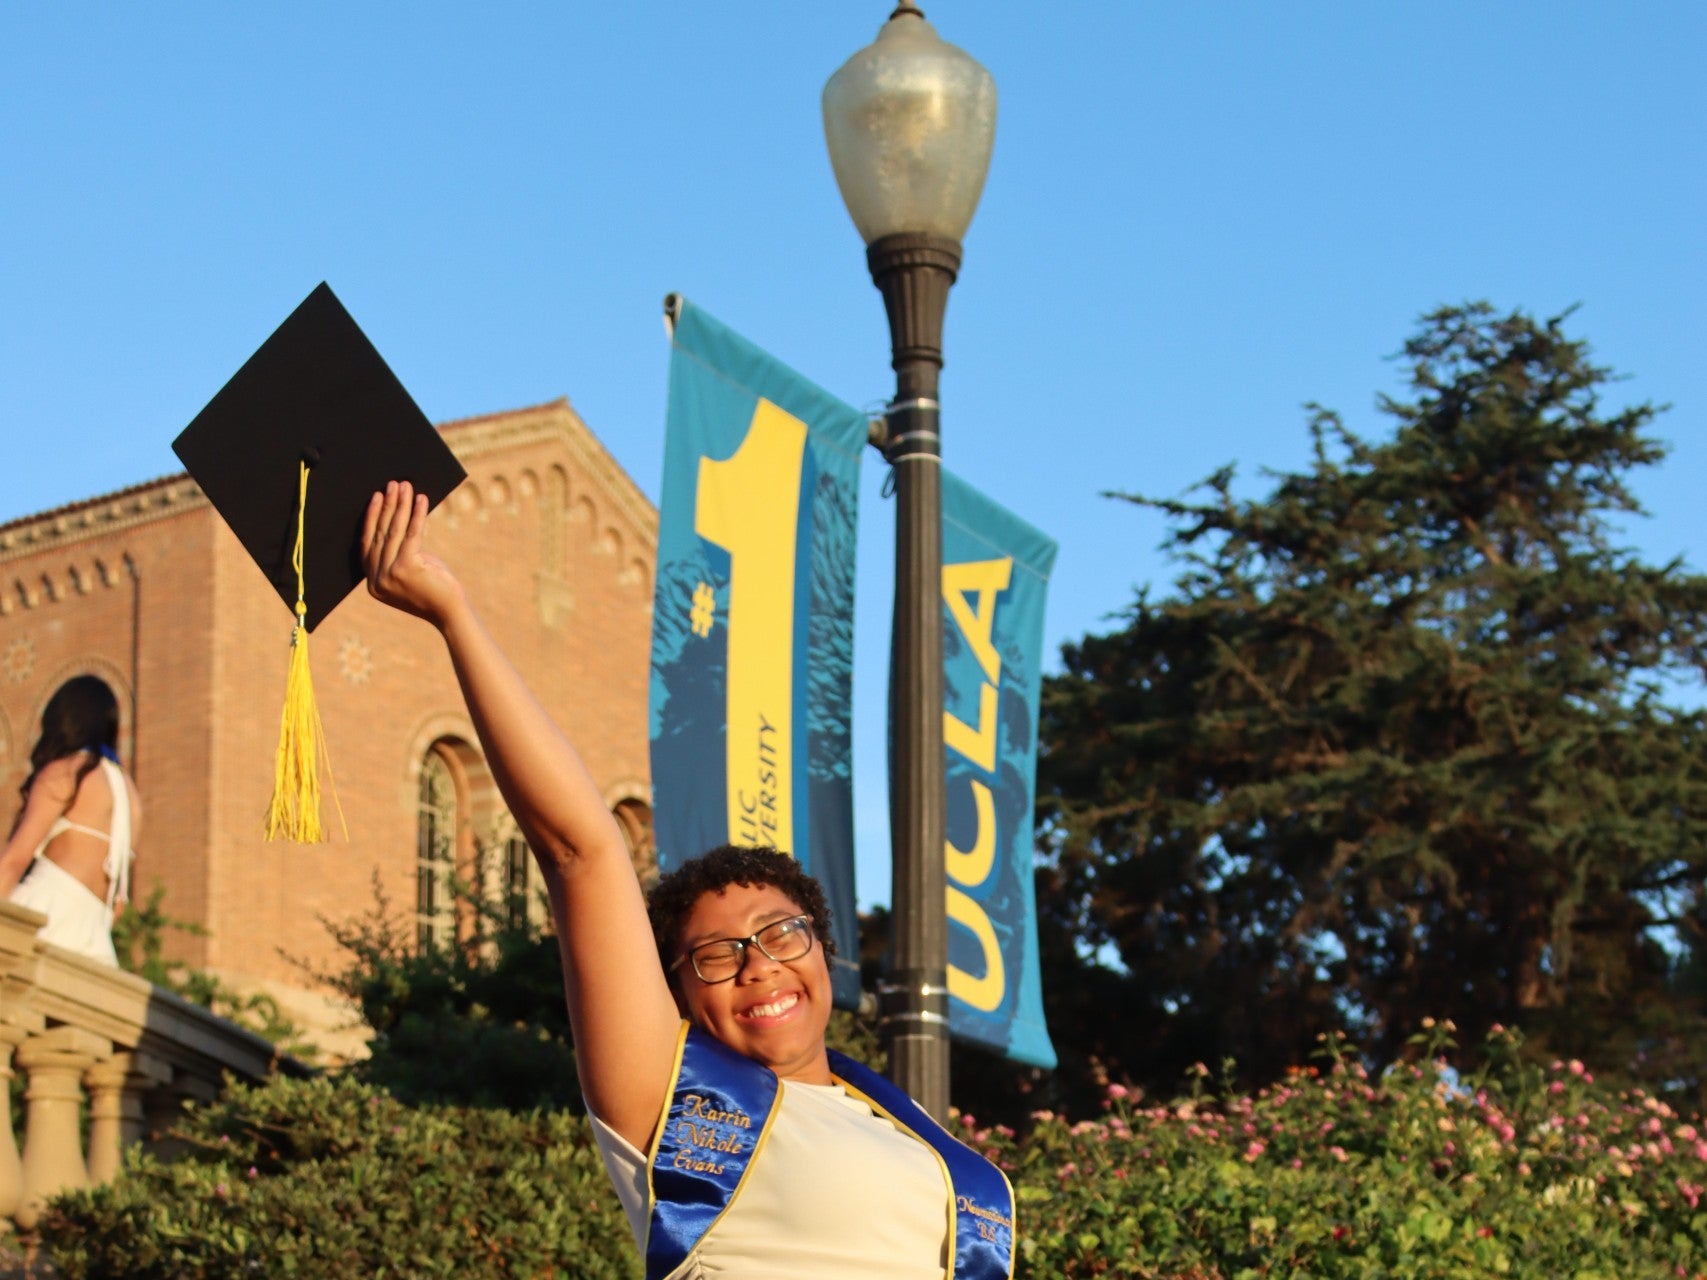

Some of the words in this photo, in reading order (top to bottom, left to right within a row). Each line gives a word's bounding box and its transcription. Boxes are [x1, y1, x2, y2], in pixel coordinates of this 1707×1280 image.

[759, 712, 778, 852] VERSITY
[941, 557, 1012, 1013] UCLA
[738, 788, 758, 846] LIC
[682, 1094, 751, 1129] Karrin
[675, 1122, 743, 1155] Nikole
[673, 1149, 725, 1175] Evans
